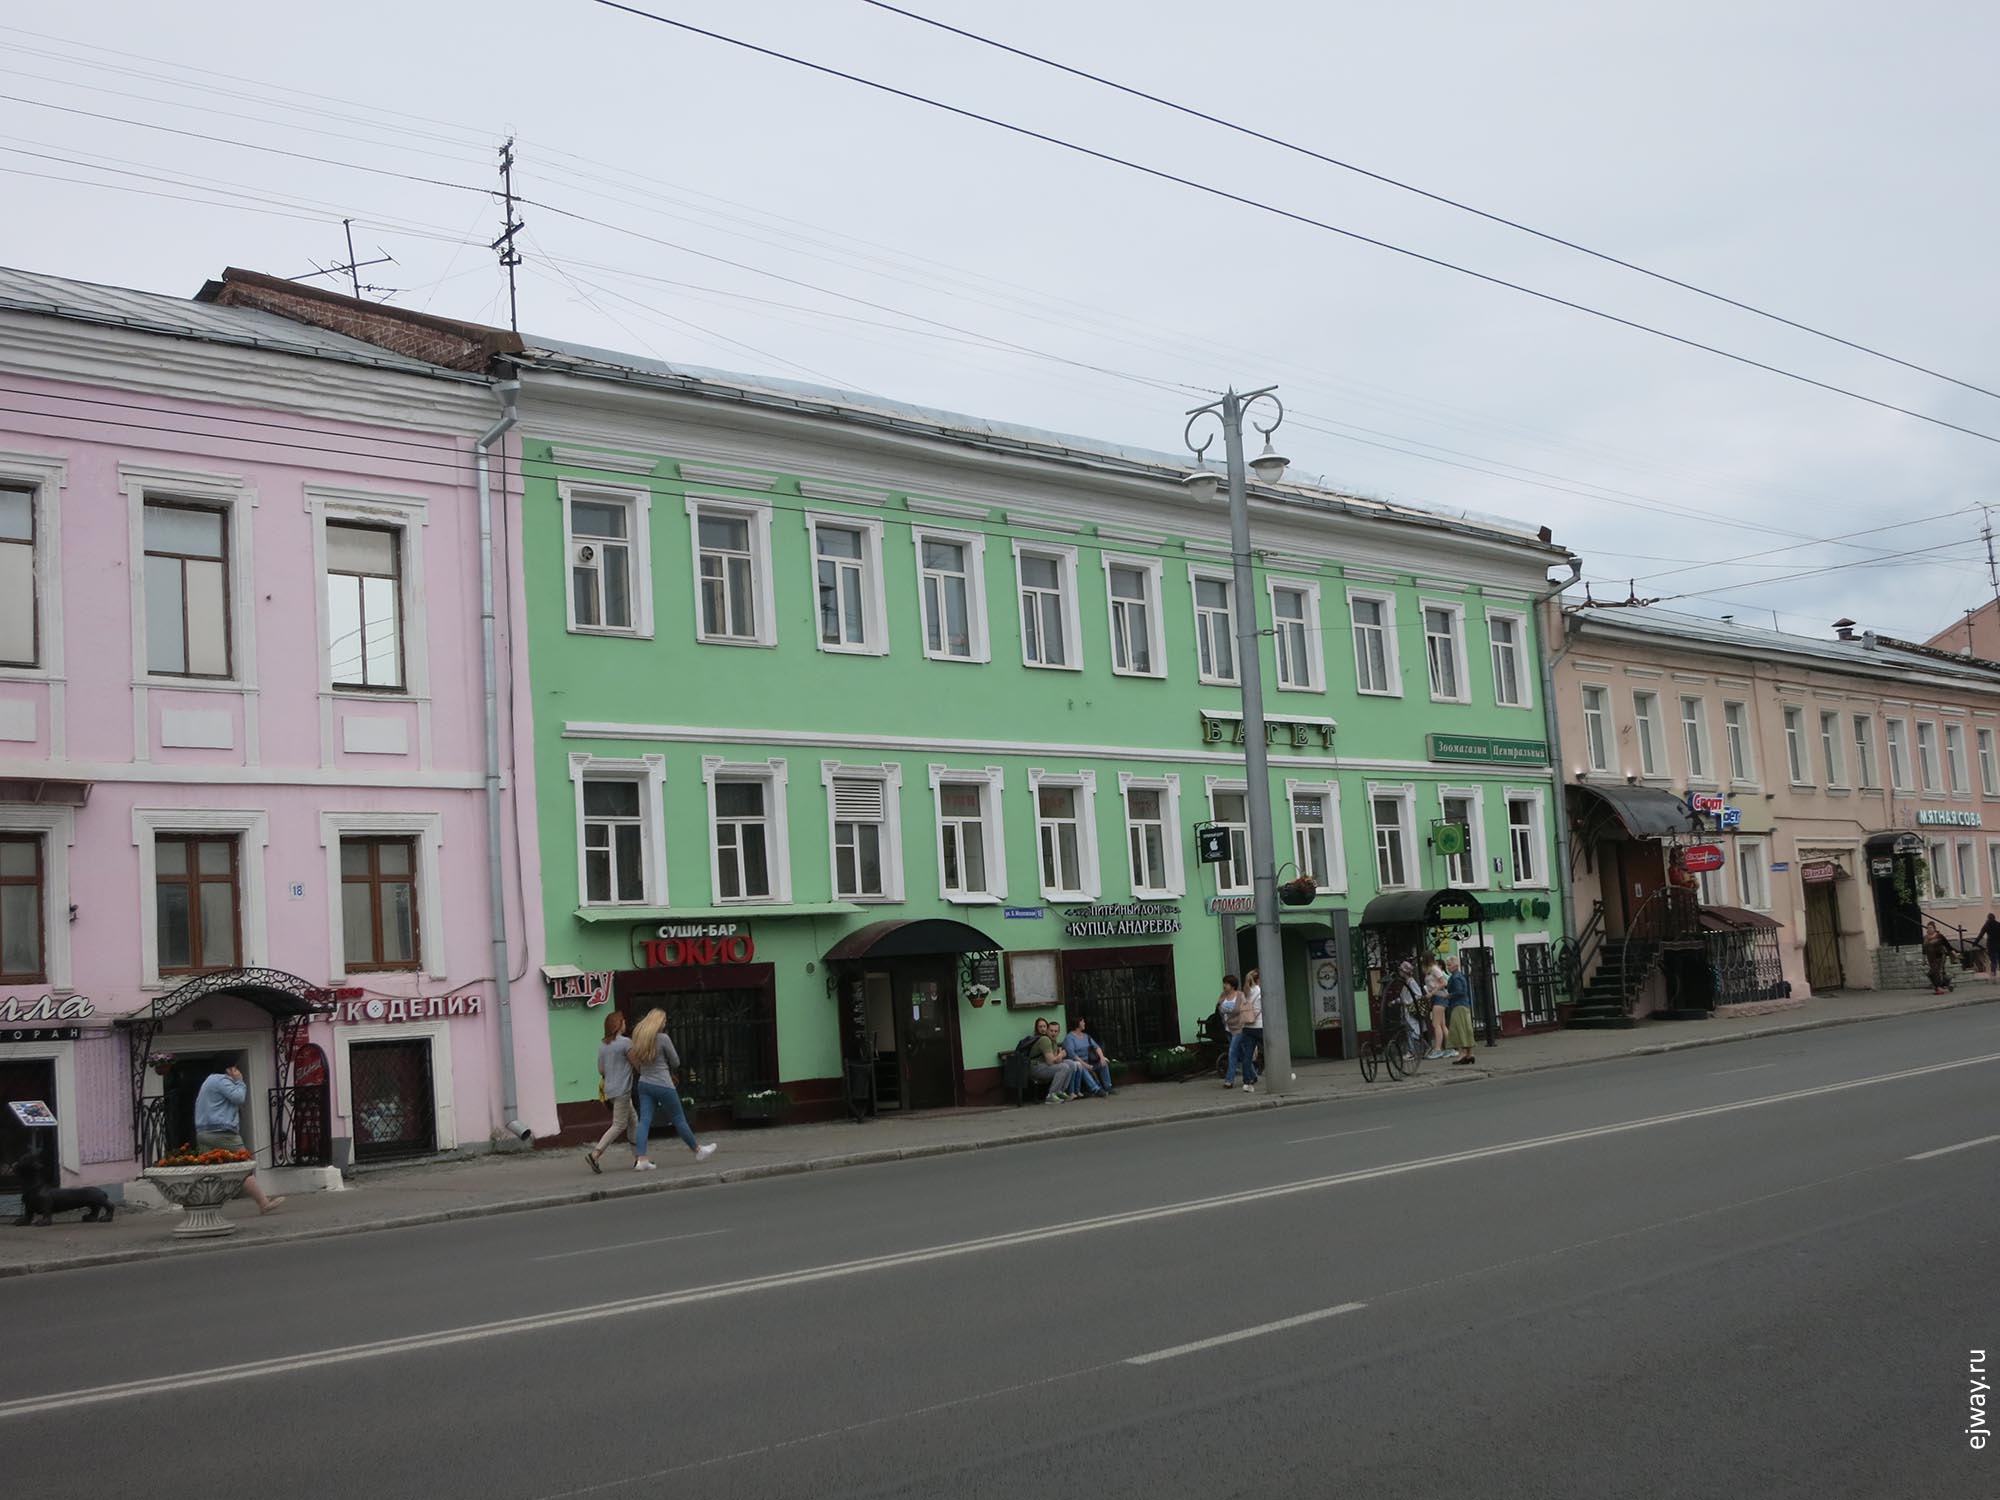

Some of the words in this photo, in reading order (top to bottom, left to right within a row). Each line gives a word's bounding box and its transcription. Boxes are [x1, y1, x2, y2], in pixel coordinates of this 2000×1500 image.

[1438, 740, 1487, 754] Зоомагазин
[1493, 744, 1545, 759] Центральный
[1919, 809, 1958, 825] МЯТНАЯ
[1958, 811, 1982, 826] СОВА
[293, 885, 303, 896] 18
[1091, 903, 1140, 916] ПИТЕЙНЫЙ
[1140, 904, 1160, 914] ДОМ
[658, 923, 737, 938] СУШИ-БАР
[639, 935, 755, 969] ТОКИО
[0, 1028, 78, 1040] ОРАН
